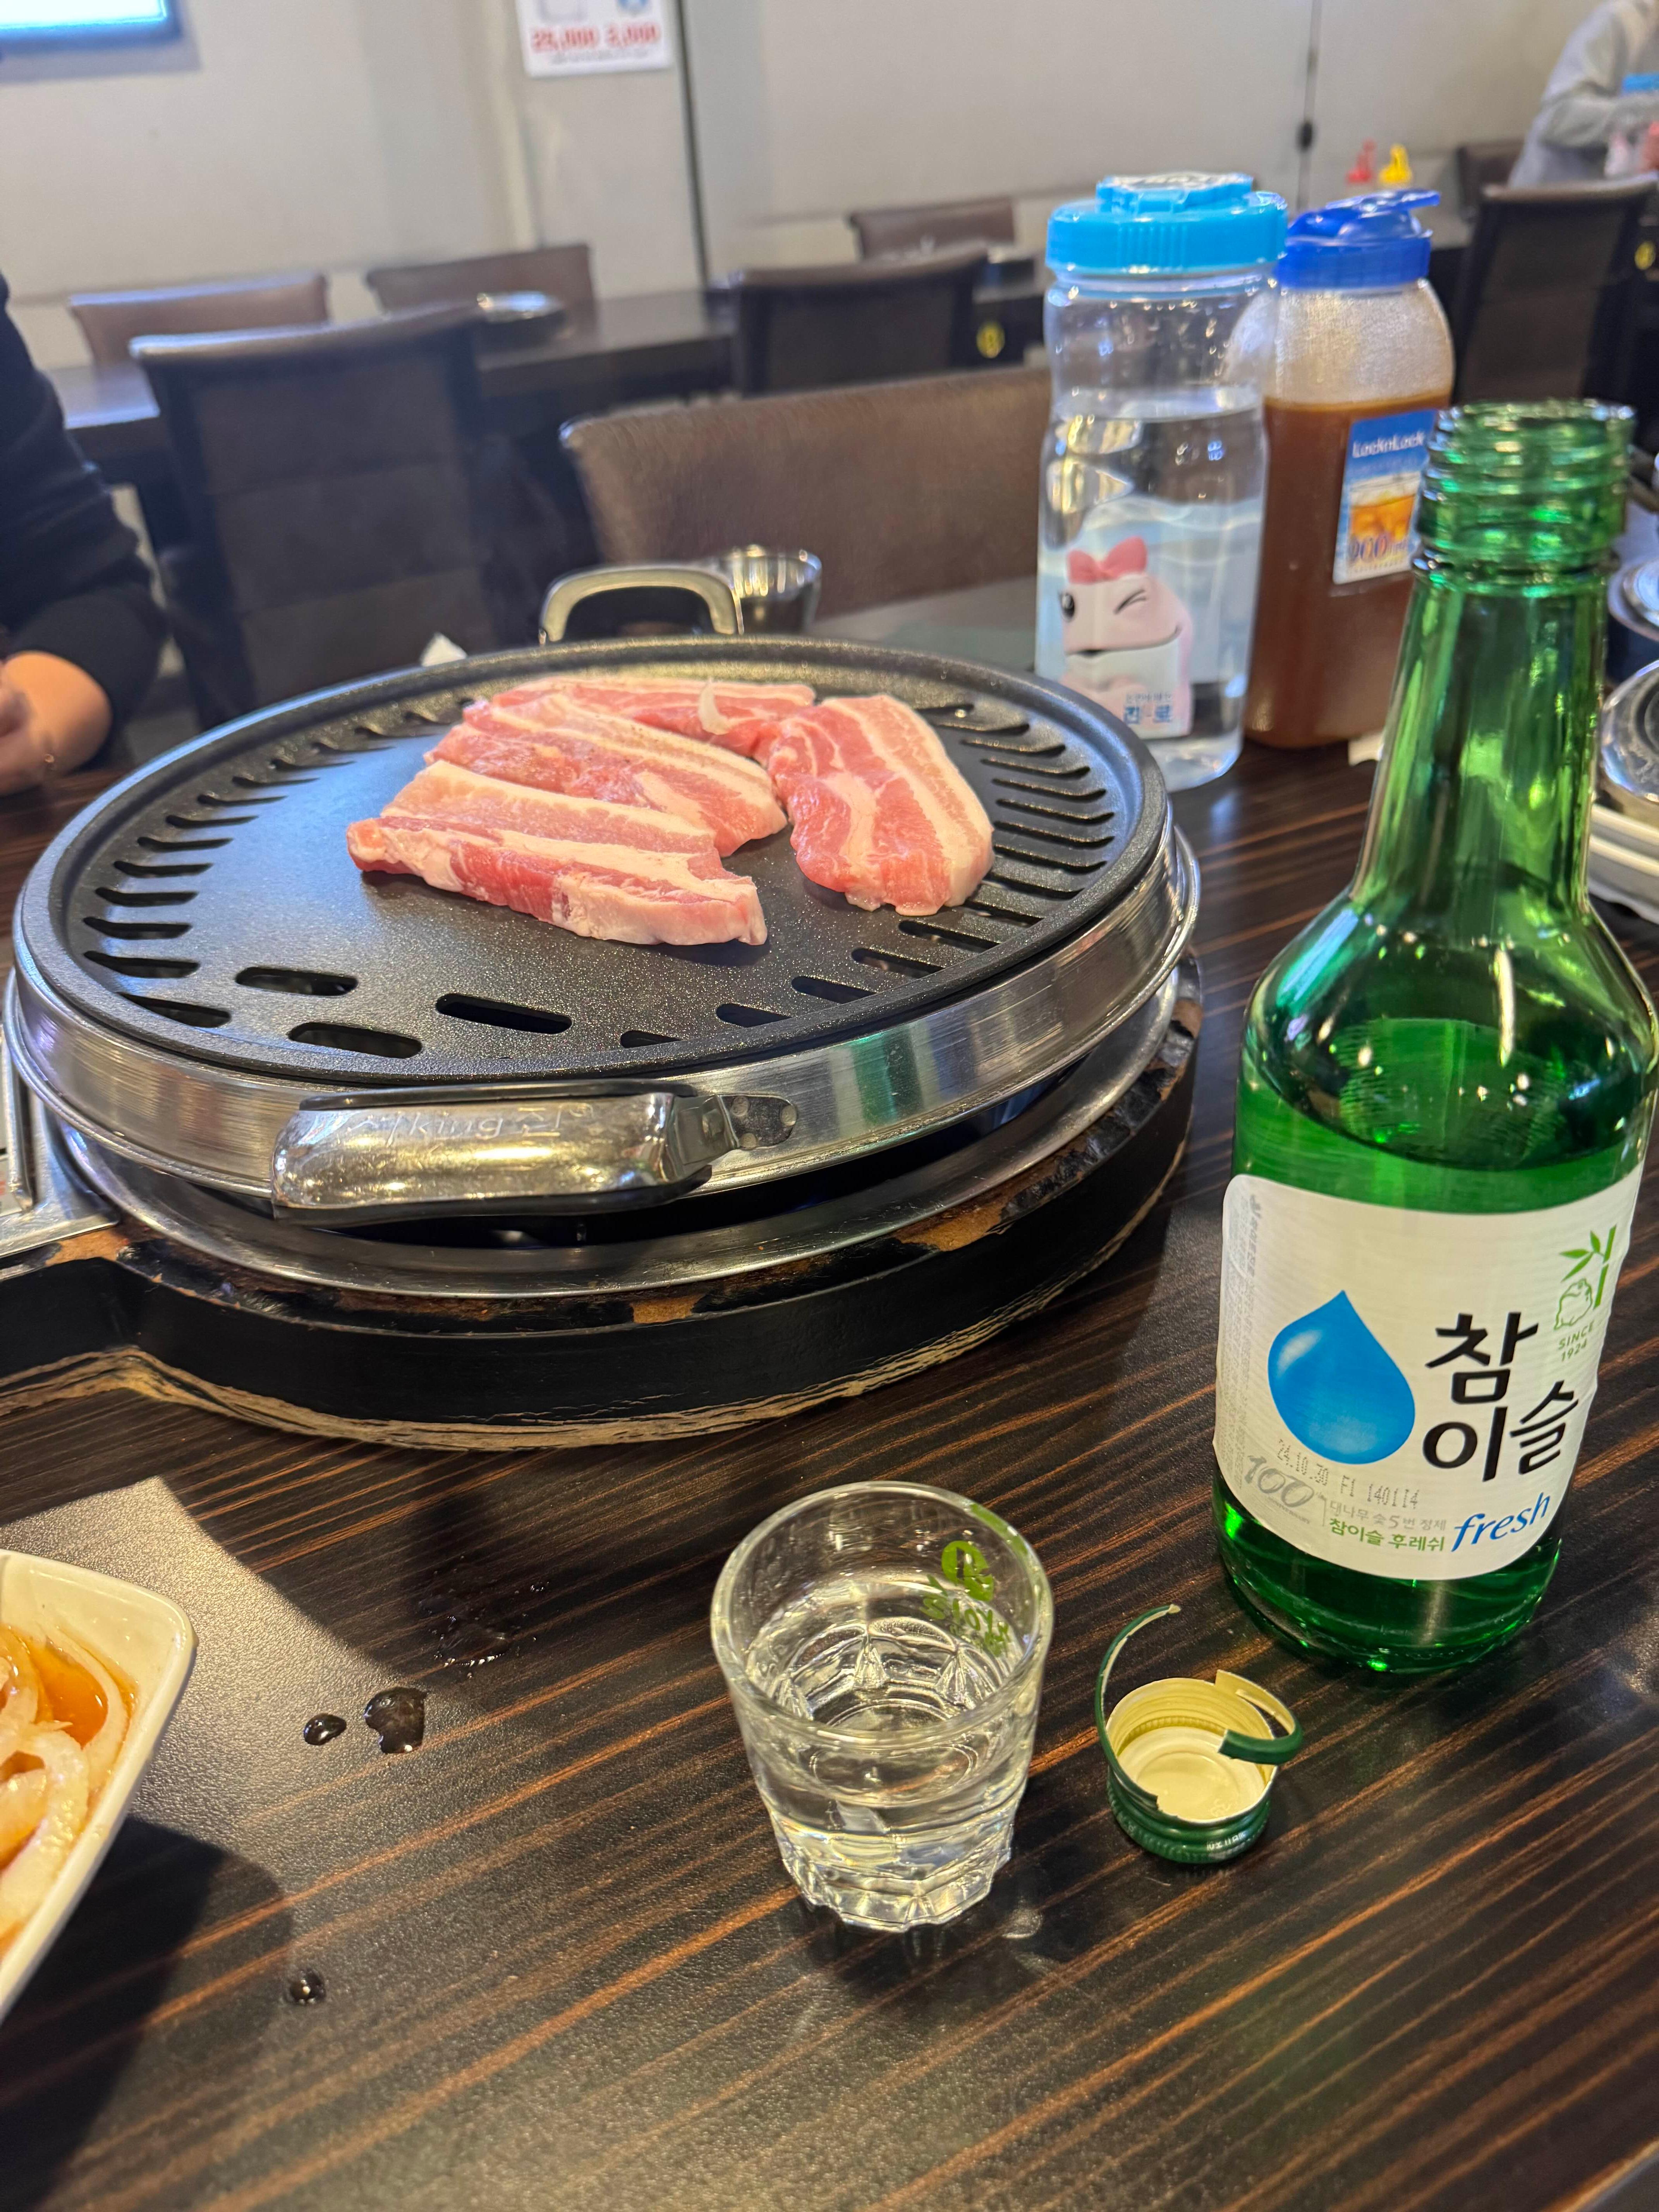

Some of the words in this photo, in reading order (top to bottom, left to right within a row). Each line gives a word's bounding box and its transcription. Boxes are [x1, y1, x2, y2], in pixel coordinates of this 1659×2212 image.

[1558, 1319, 1595, 1350] SINCE
[1561, 1338, 1587, 1362] 1924
[1329, 1518, 1384, 1546] 참이슬
[1388, 1534, 1445, 1551] 후레쉬
[1451, 1492, 1551, 1552] fresh
